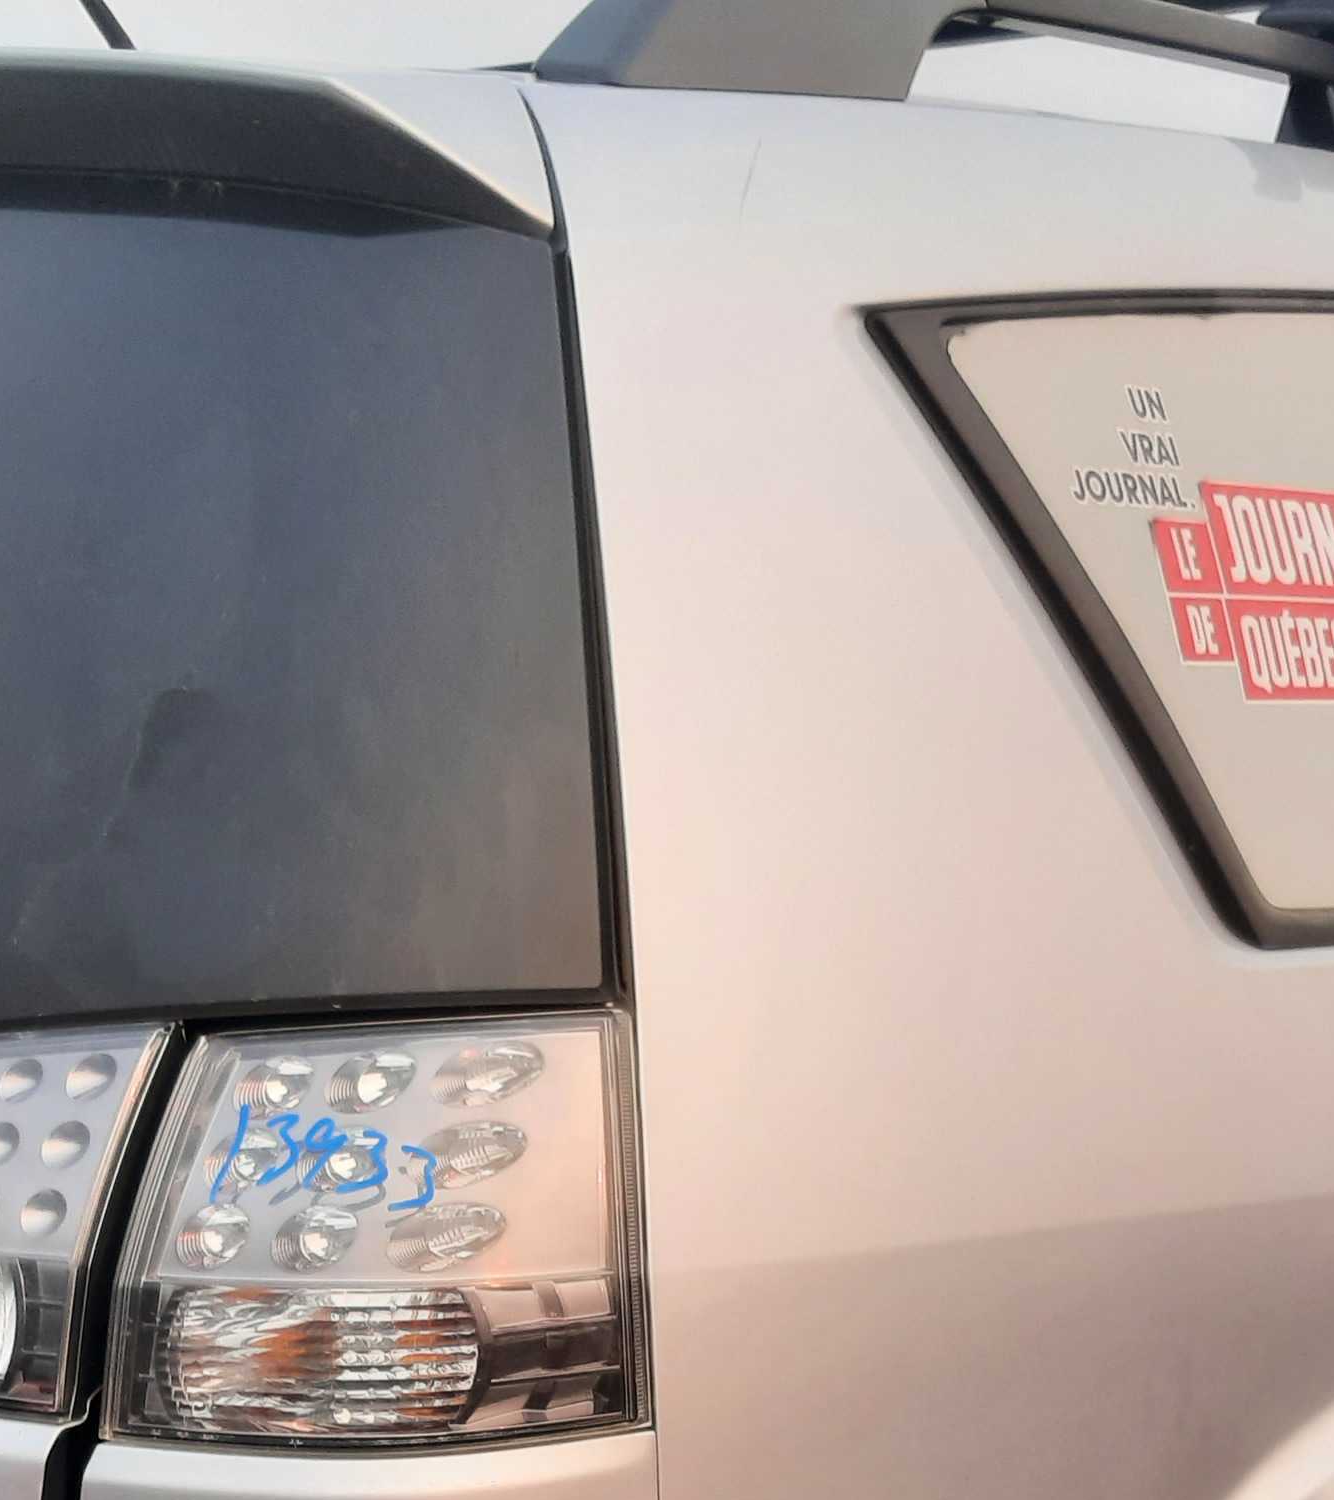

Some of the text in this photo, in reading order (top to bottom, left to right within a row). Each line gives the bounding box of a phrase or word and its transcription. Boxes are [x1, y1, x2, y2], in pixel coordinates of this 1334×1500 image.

[1129, 388, 1165, 421] UN
[1120, 431, 1180, 467] VRAI
[1074, 470, 1196, 509] JOURNAL.
[1171, 528, 1202, 581] LE
[1186, 605, 1219, 655] DE
[209, 1104, 436, 1211] 13933
